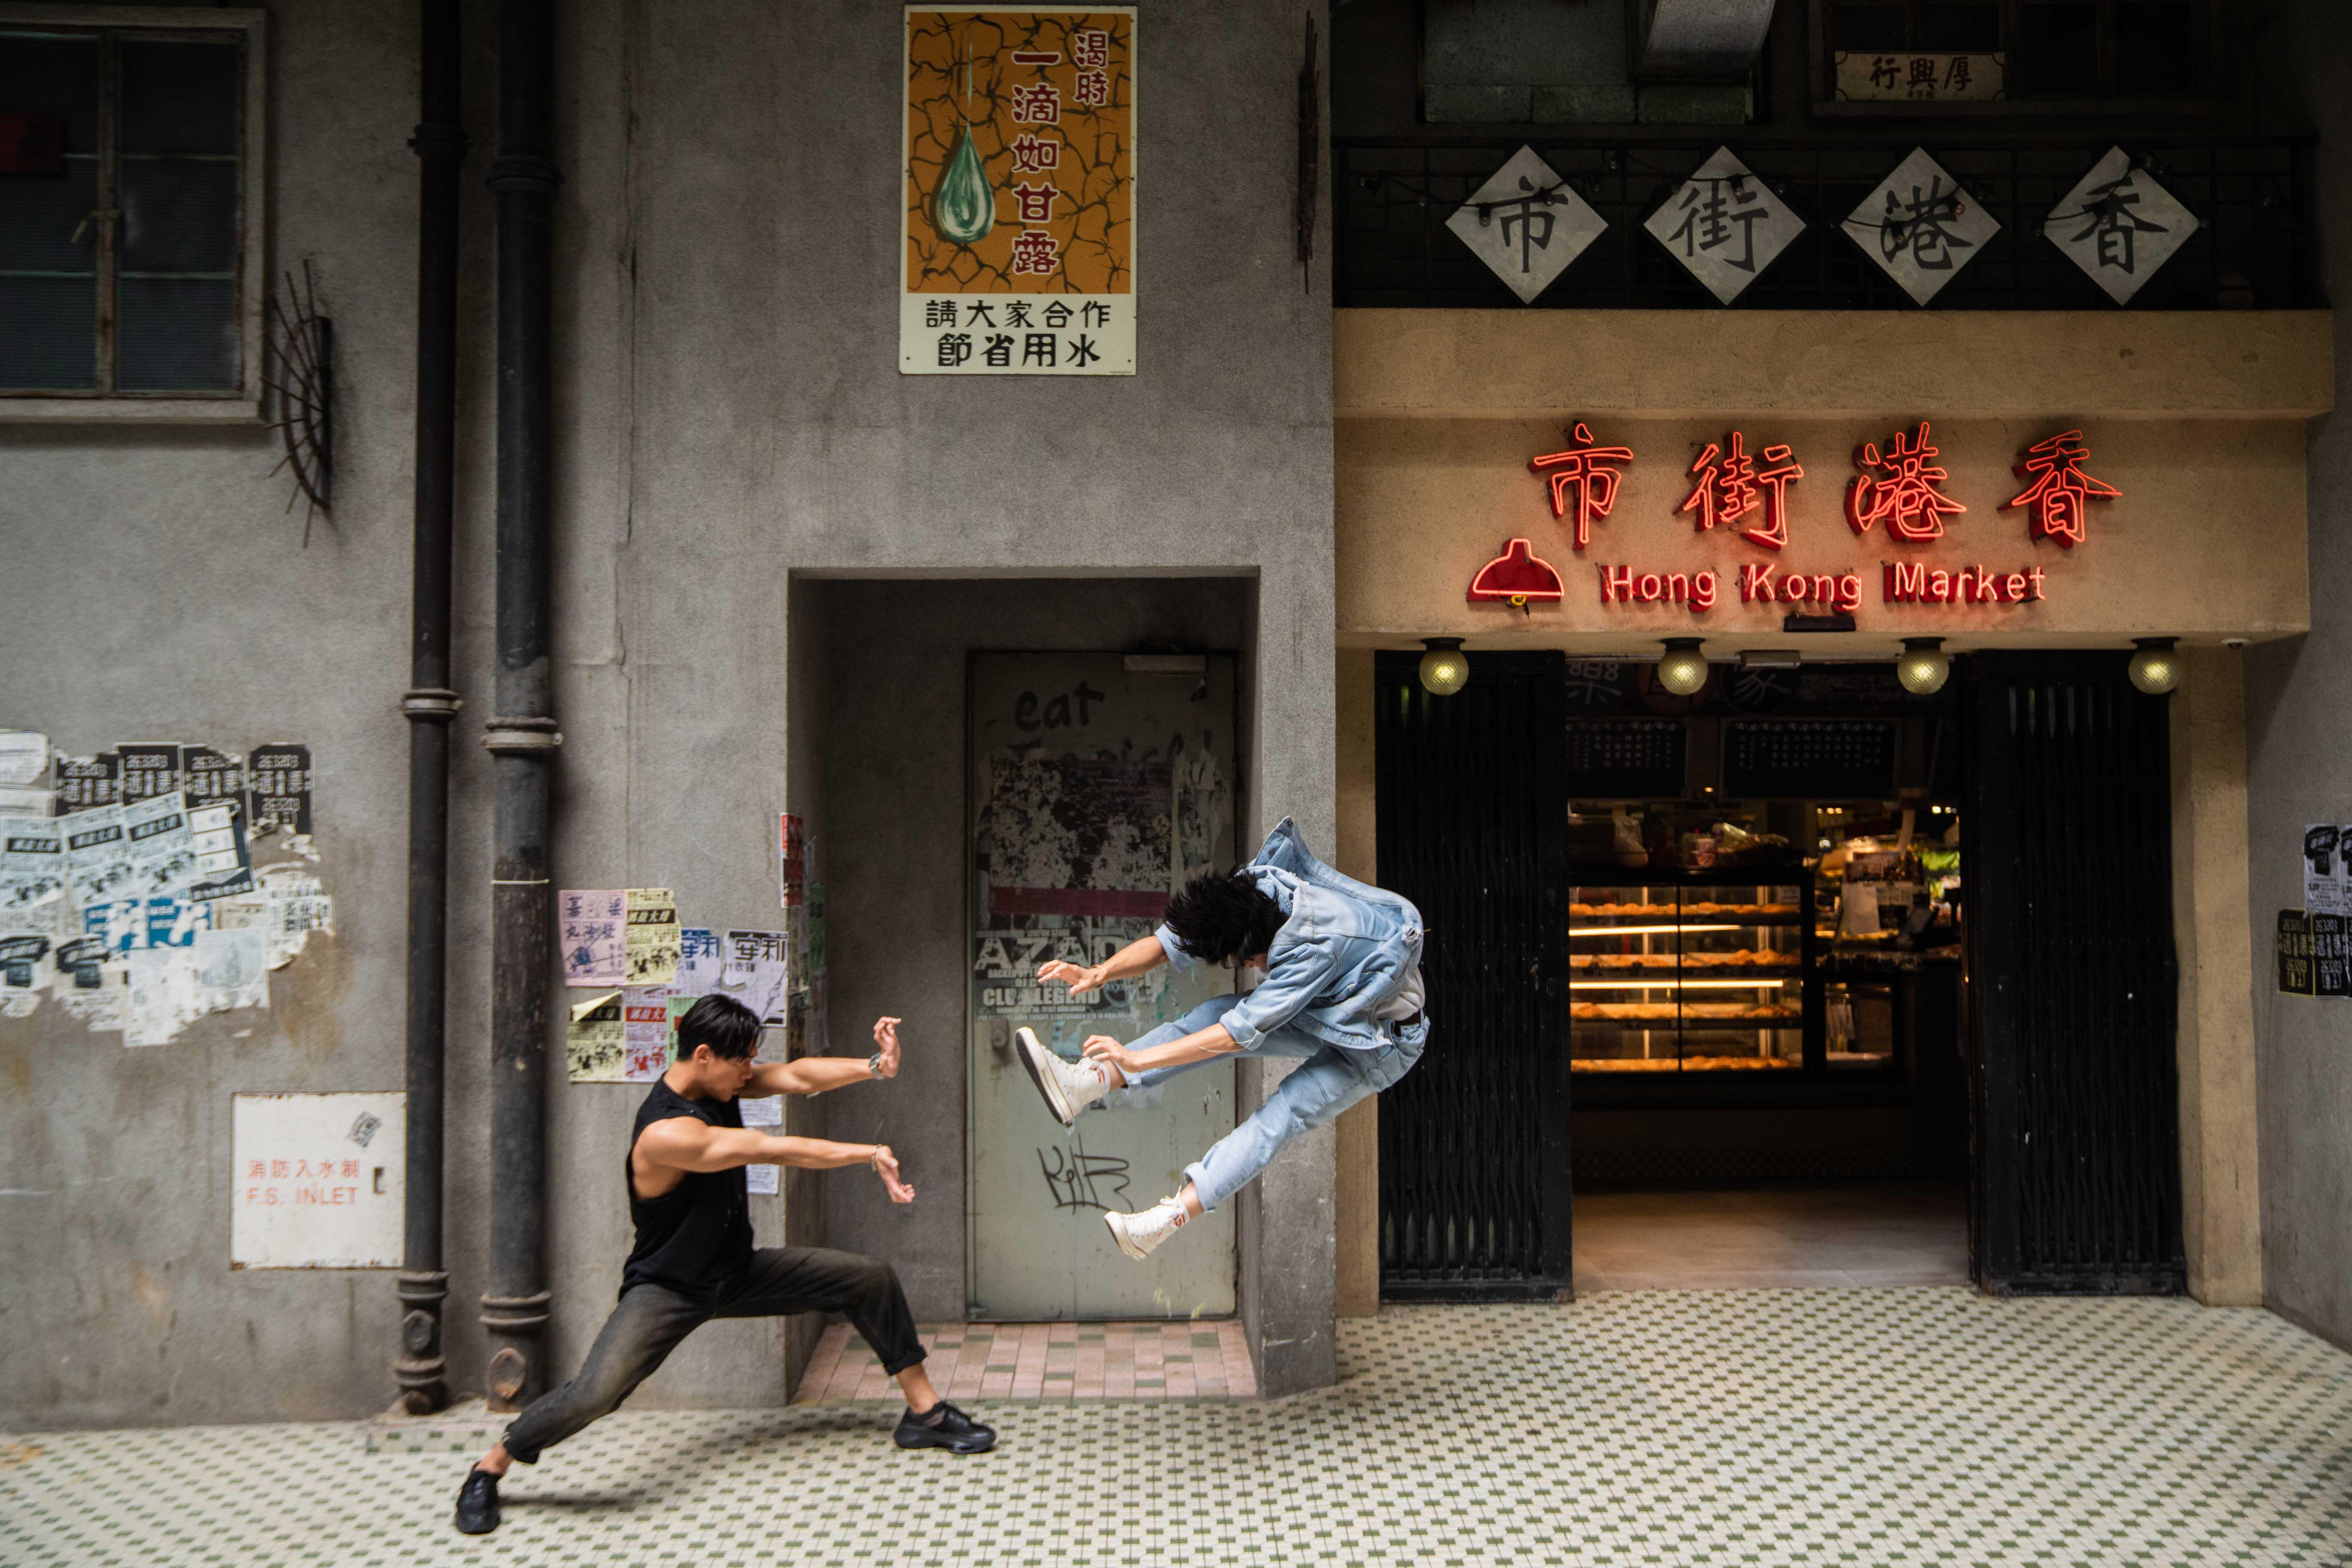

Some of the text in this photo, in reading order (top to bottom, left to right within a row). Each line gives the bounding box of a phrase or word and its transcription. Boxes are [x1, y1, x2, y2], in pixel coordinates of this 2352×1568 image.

[1075, 30, 1109, 106] 渴時
[1011, 50, 1061, 275] 一滴如甘露
[926, 300, 1111, 328] 請大家合作
[938, 333, 1100, 368] 節省用水
[1607, 561, 2046, 610] Hong Kong Market
[1014, 680, 1105, 731] eat
[247, 1159, 360, 1179] 消防入水制
[247, 1187, 359, 1206] F.S. INLET
